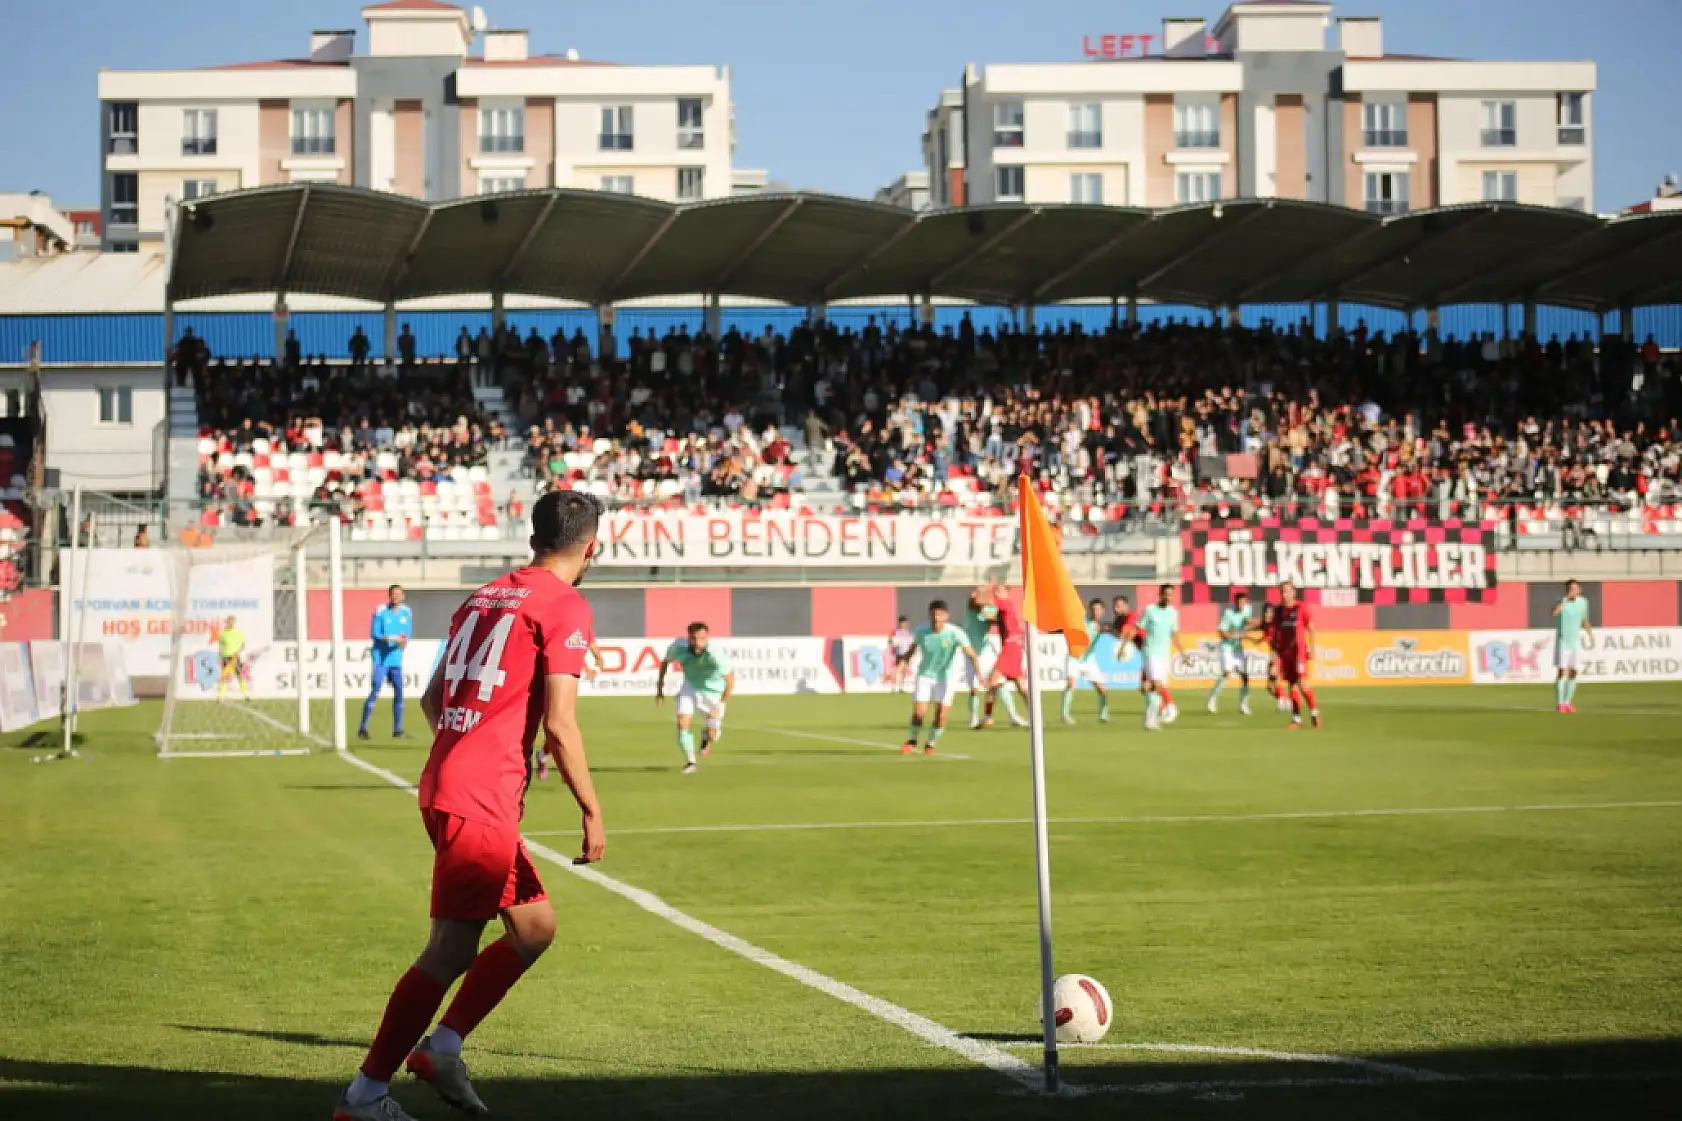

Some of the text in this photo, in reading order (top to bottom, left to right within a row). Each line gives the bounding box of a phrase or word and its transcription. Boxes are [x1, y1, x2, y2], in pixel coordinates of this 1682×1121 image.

[1083, 33, 1154, 57] LEFT
[708, 518, 897, 558] BENDEN
[1204, 529, 1487, 588] GÖLKENTLİLER
[1603, 633, 1672, 650] ALANI
[444, 610, 516, 702] 44
[1370, 651, 1462, 675] Güvercin
[1579, 657, 1682, 676] ZE AYIRD
